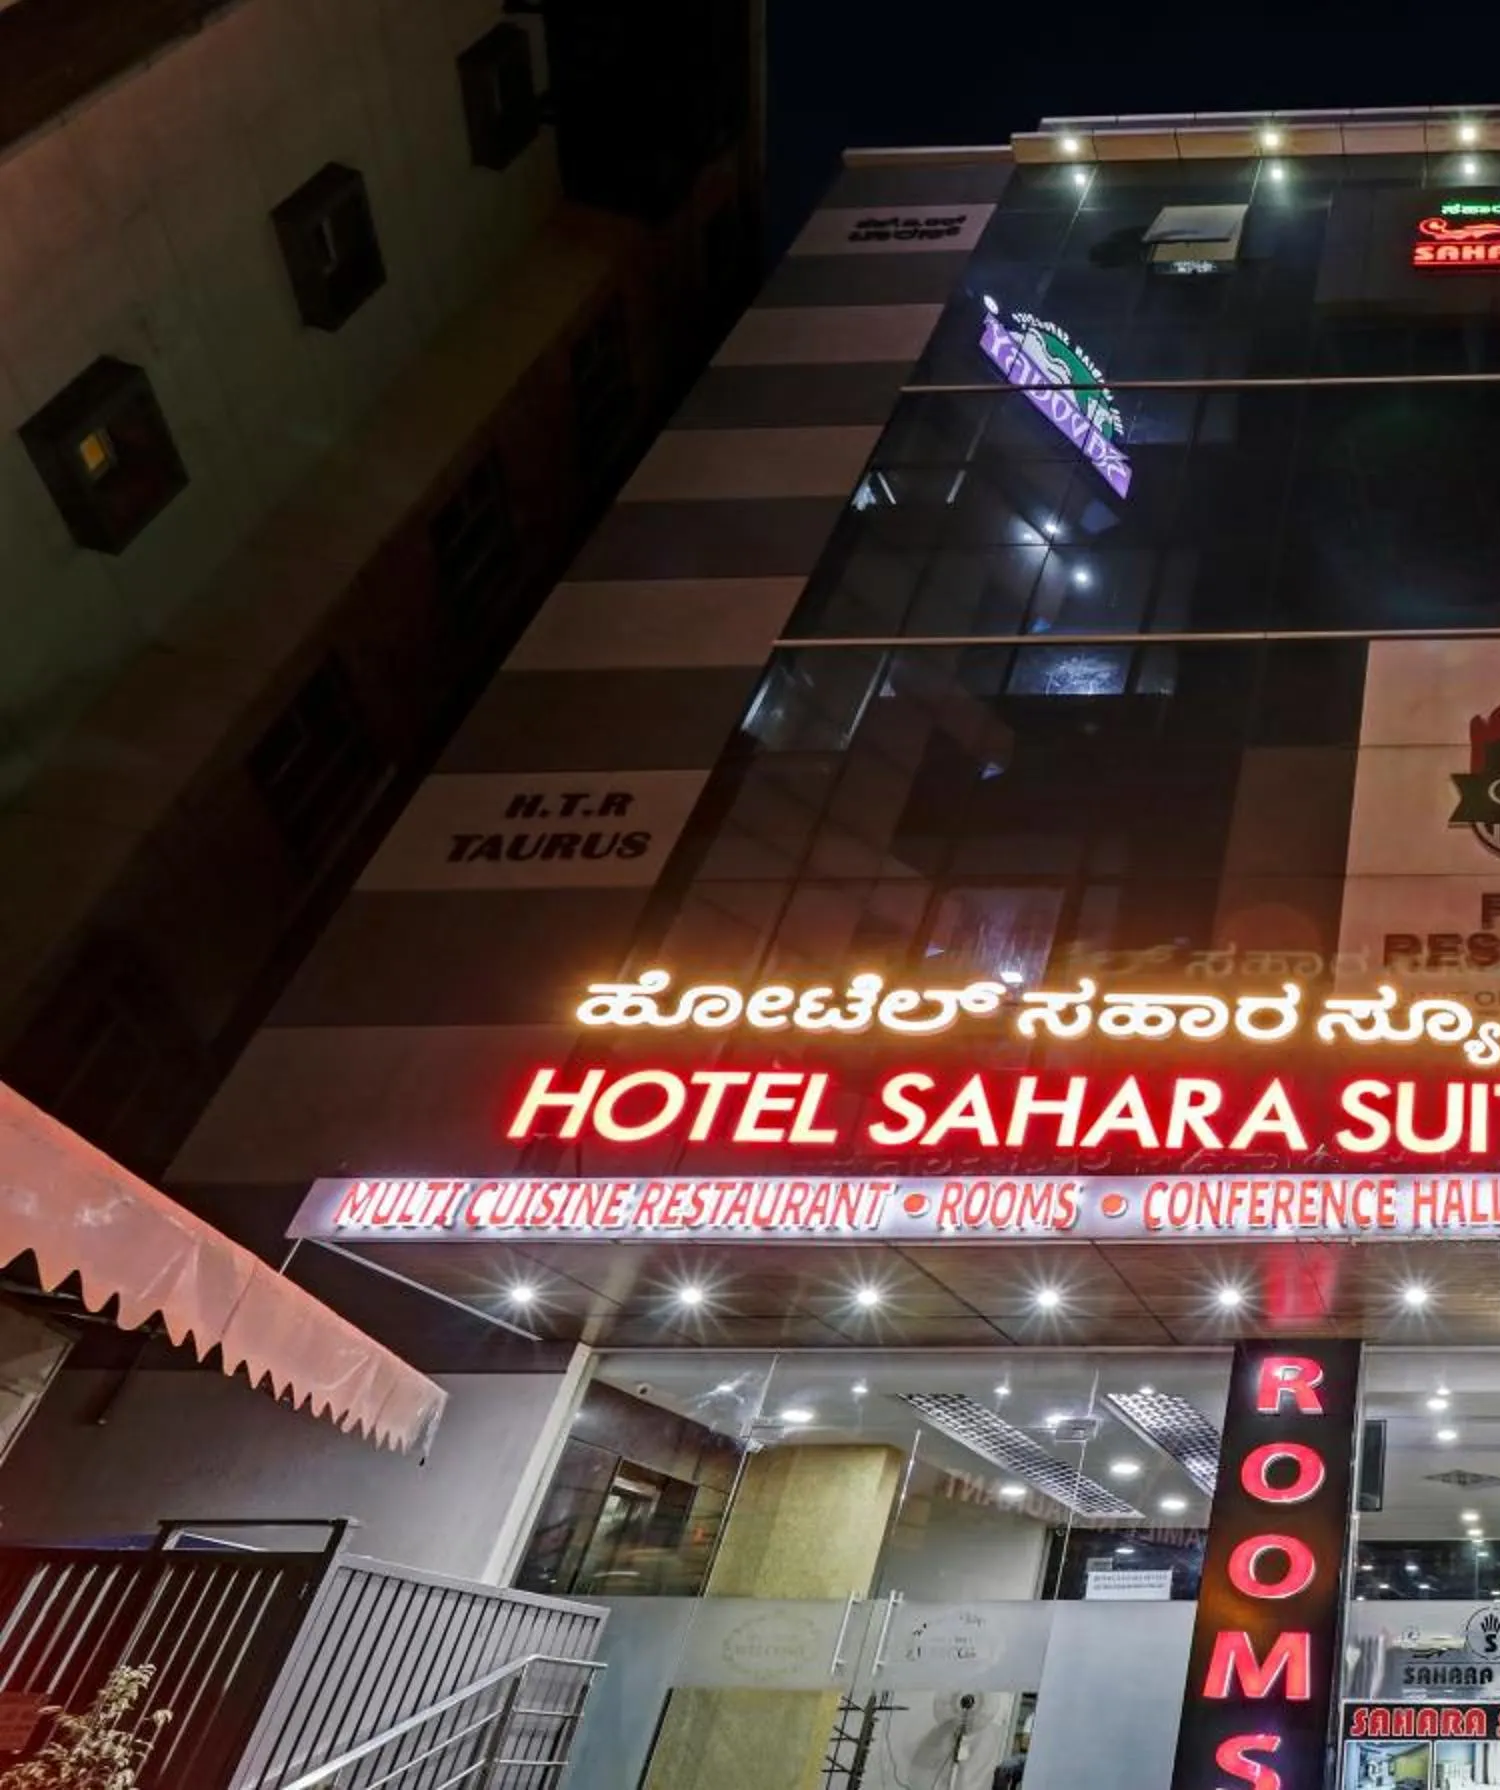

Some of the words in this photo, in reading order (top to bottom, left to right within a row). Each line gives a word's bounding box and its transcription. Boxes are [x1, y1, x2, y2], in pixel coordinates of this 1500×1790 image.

[505, 792, 634, 819] H.T.R
[446, 832, 652, 863] TAURUS
[576, 969, 1006, 1034] ಹೋಟೆಲ್
[1017, 979, 1301, 1041] ಸಹಾರ
[507, 1069, 837, 1144] HOTEL
[869, 1073, 1307, 1150] SAHARA
[334, 1181, 467, 1227] MULTI
[465, 1181, 627, 1229] CUISINE
[633, 1181, 893, 1230] RESTAURANT
[937, 1181, 1079, 1231] ROOMS
[1142, 1179, 1397, 1230] CONFERENCE
[1203, 1356, 1326, 1790] ROOMS
[1403, 1666, 1493, 1685] SAHARA
[1351, 1707, 1487, 1737] SAHARA
